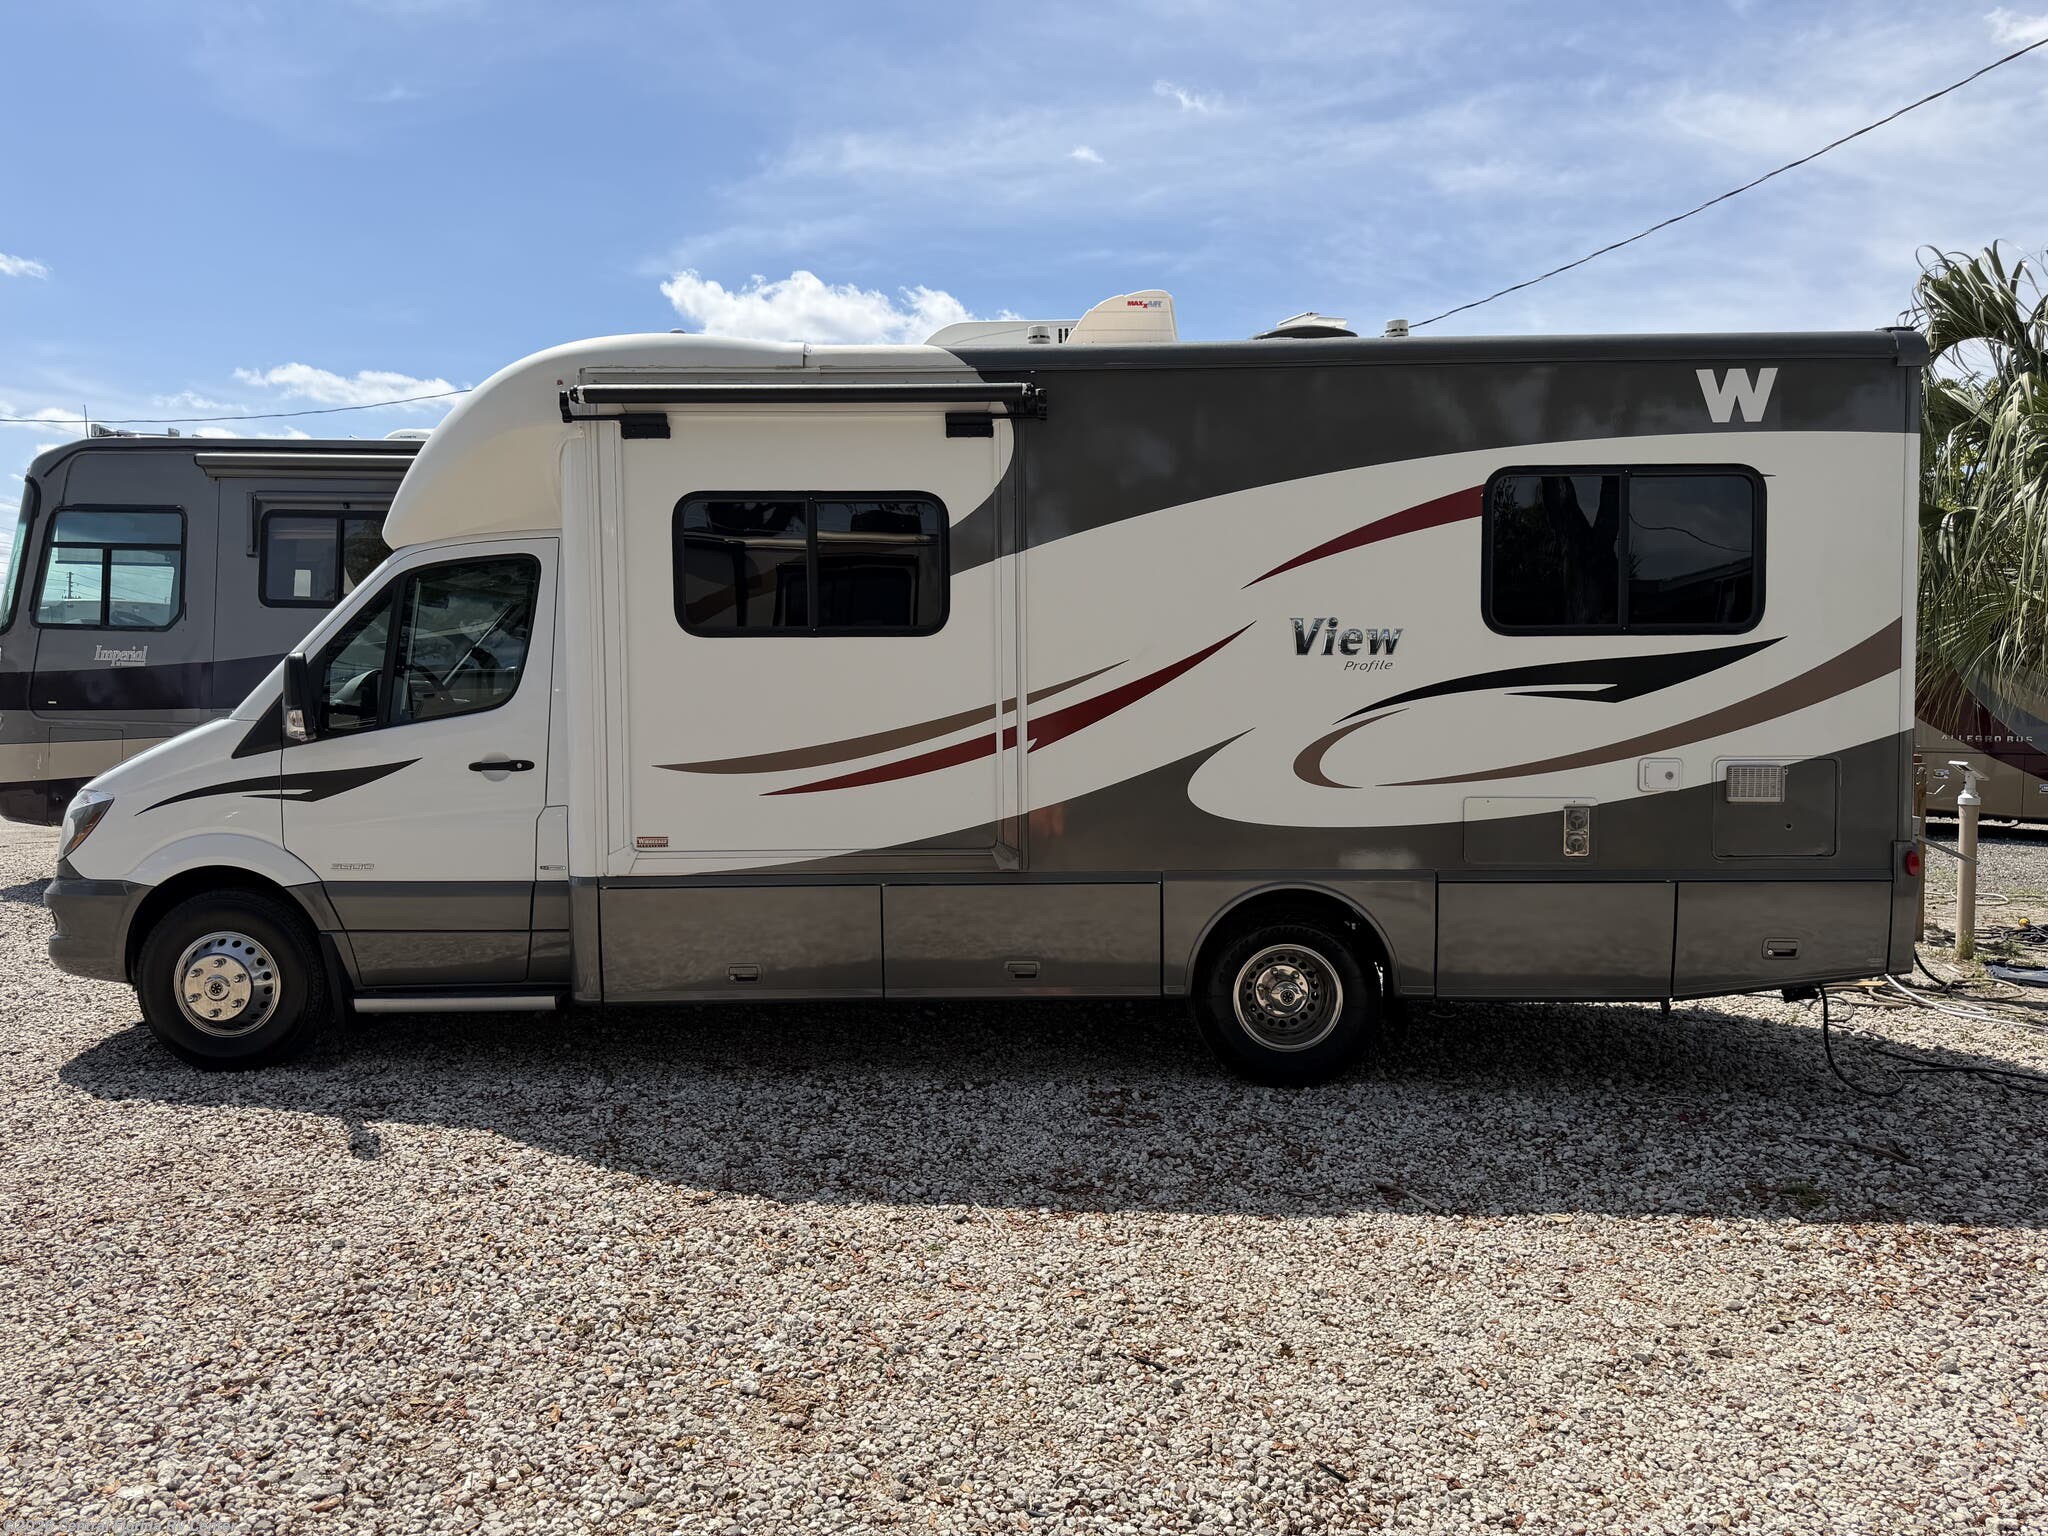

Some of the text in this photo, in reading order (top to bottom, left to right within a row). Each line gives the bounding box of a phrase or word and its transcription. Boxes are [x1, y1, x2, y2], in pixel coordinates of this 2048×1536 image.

[1695, 367, 1778, 423] W
[1289, 616, 1404, 656] View
[94, 644, 149, 667] Imperial
[1343, 660, 1394, 672] Profile
[1941, 735, 2033, 743] ALLEGRO BUS
